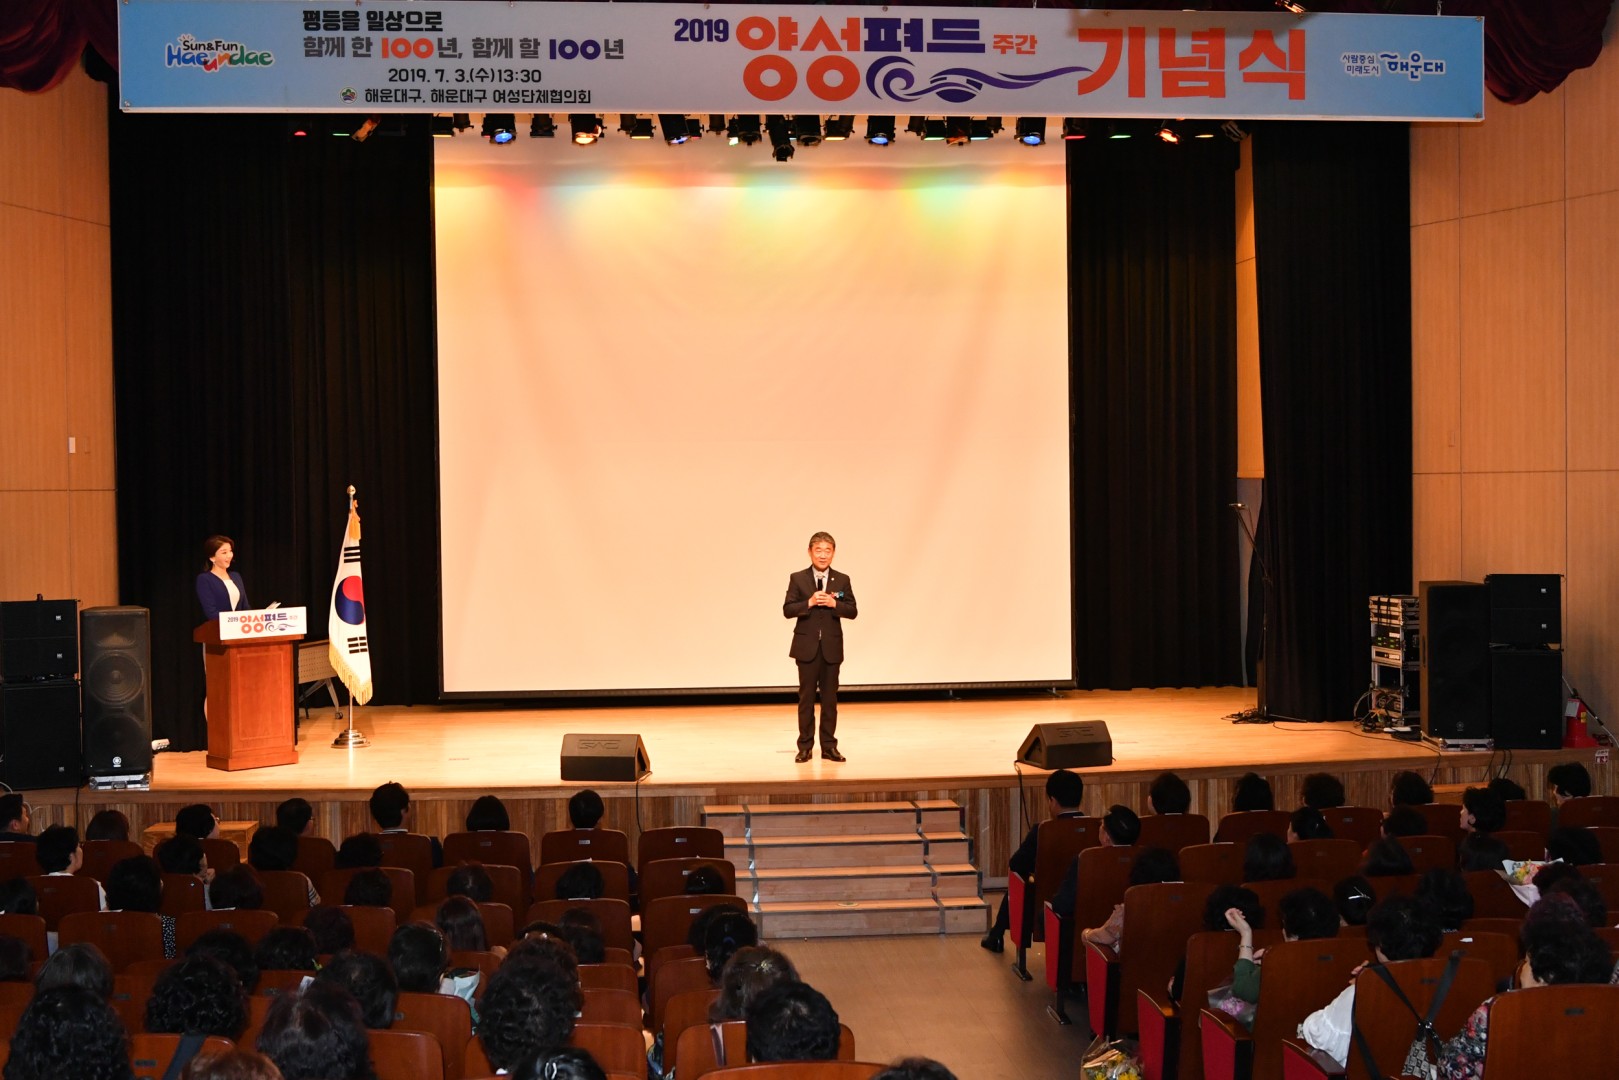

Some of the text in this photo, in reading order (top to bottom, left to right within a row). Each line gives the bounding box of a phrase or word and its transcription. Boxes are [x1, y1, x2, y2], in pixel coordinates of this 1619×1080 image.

[303, 10, 443, 32] 평등을 일상으로
[183, 40, 238, 51] Sun&Fun
[303, 36, 346, 58] 함께
[351, 36, 373, 58] 한
[472, 37, 513, 59] 함께
[519, 38, 540, 59] 할
[674, 18, 729, 42] 2019
[992, 34, 1038, 55] 주간
[1078, 27, 1306, 100] 기념식
[1342, 54, 1375, 65] 사람중심
[1380, 53, 1444, 79] 해운대
[1346, 65, 1379, 75] 미래도시
[430, 89, 487, 103] 해운대구
[493, 89, 591, 104] 여성단체협의회
